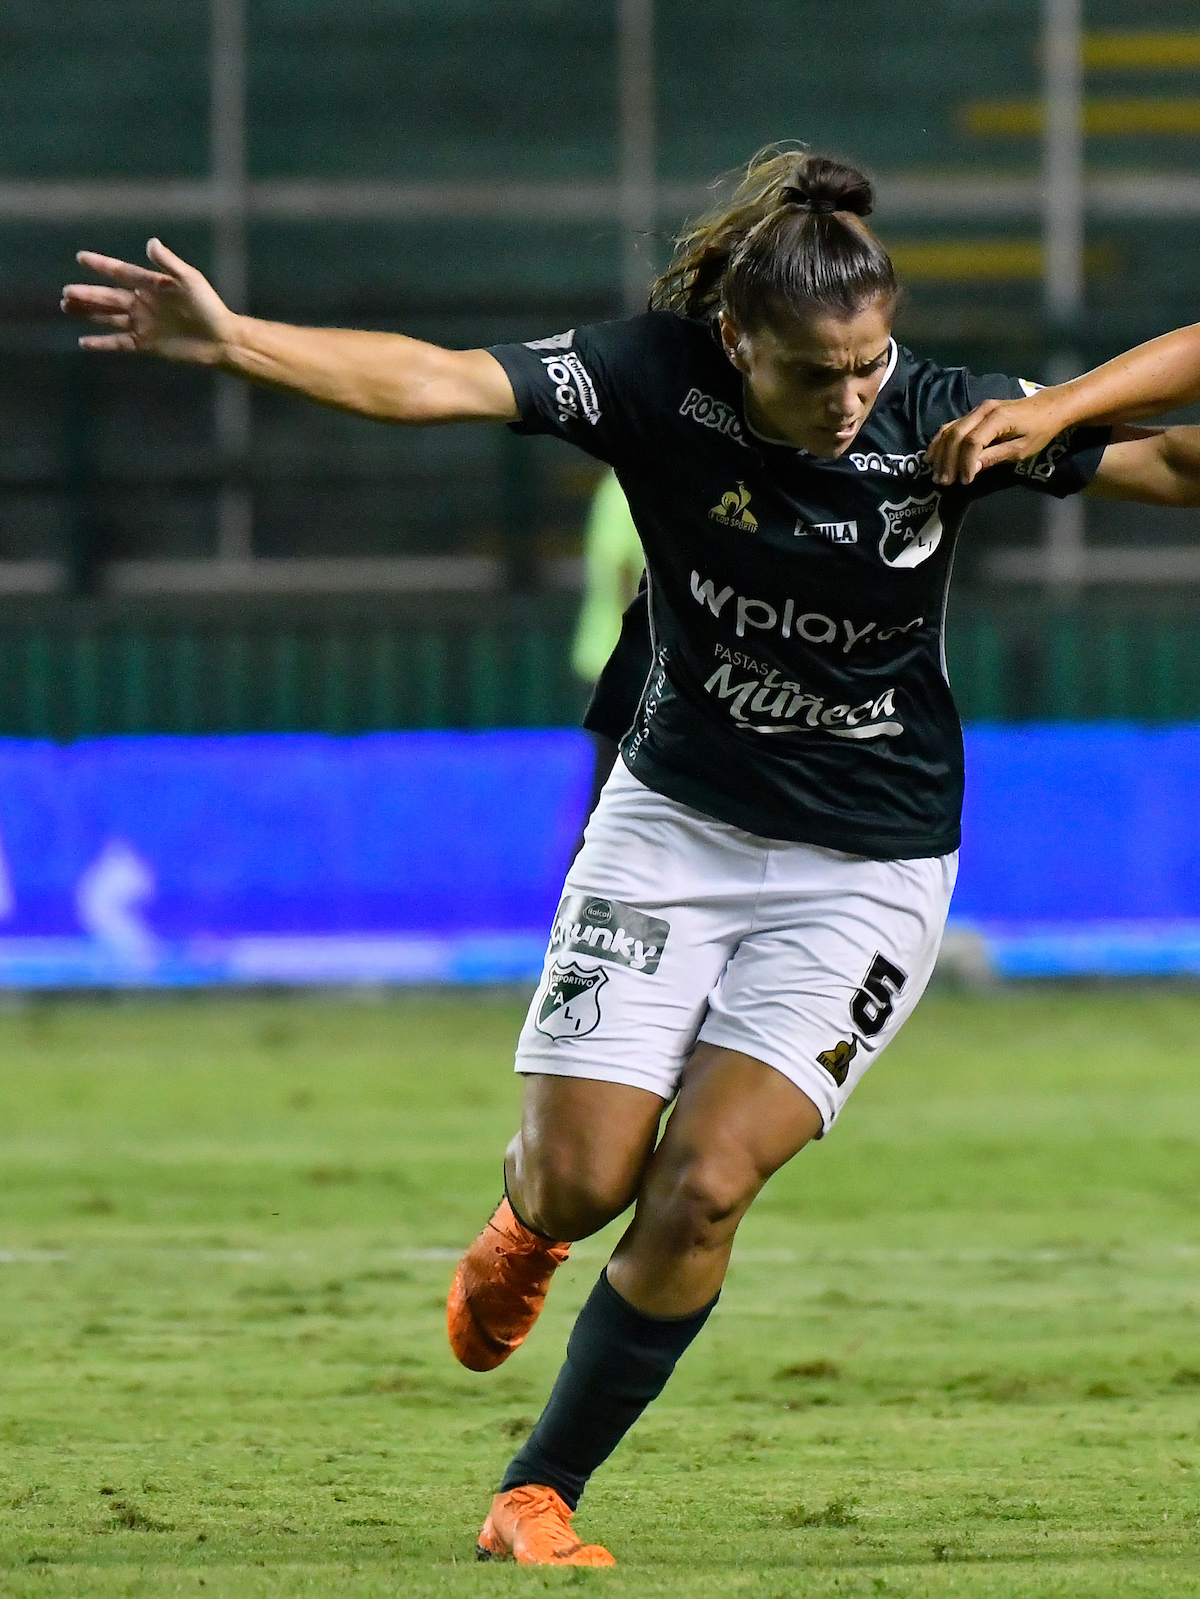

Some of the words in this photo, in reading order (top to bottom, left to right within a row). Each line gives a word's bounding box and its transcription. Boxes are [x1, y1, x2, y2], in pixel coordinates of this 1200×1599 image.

[541, 354, 579, 422] 100%
[888, 503, 935, 521] DEPORTIVO
[714, 643, 769, 675] PASTAS
[552, 974, 594, 987] DEPORTIVO
